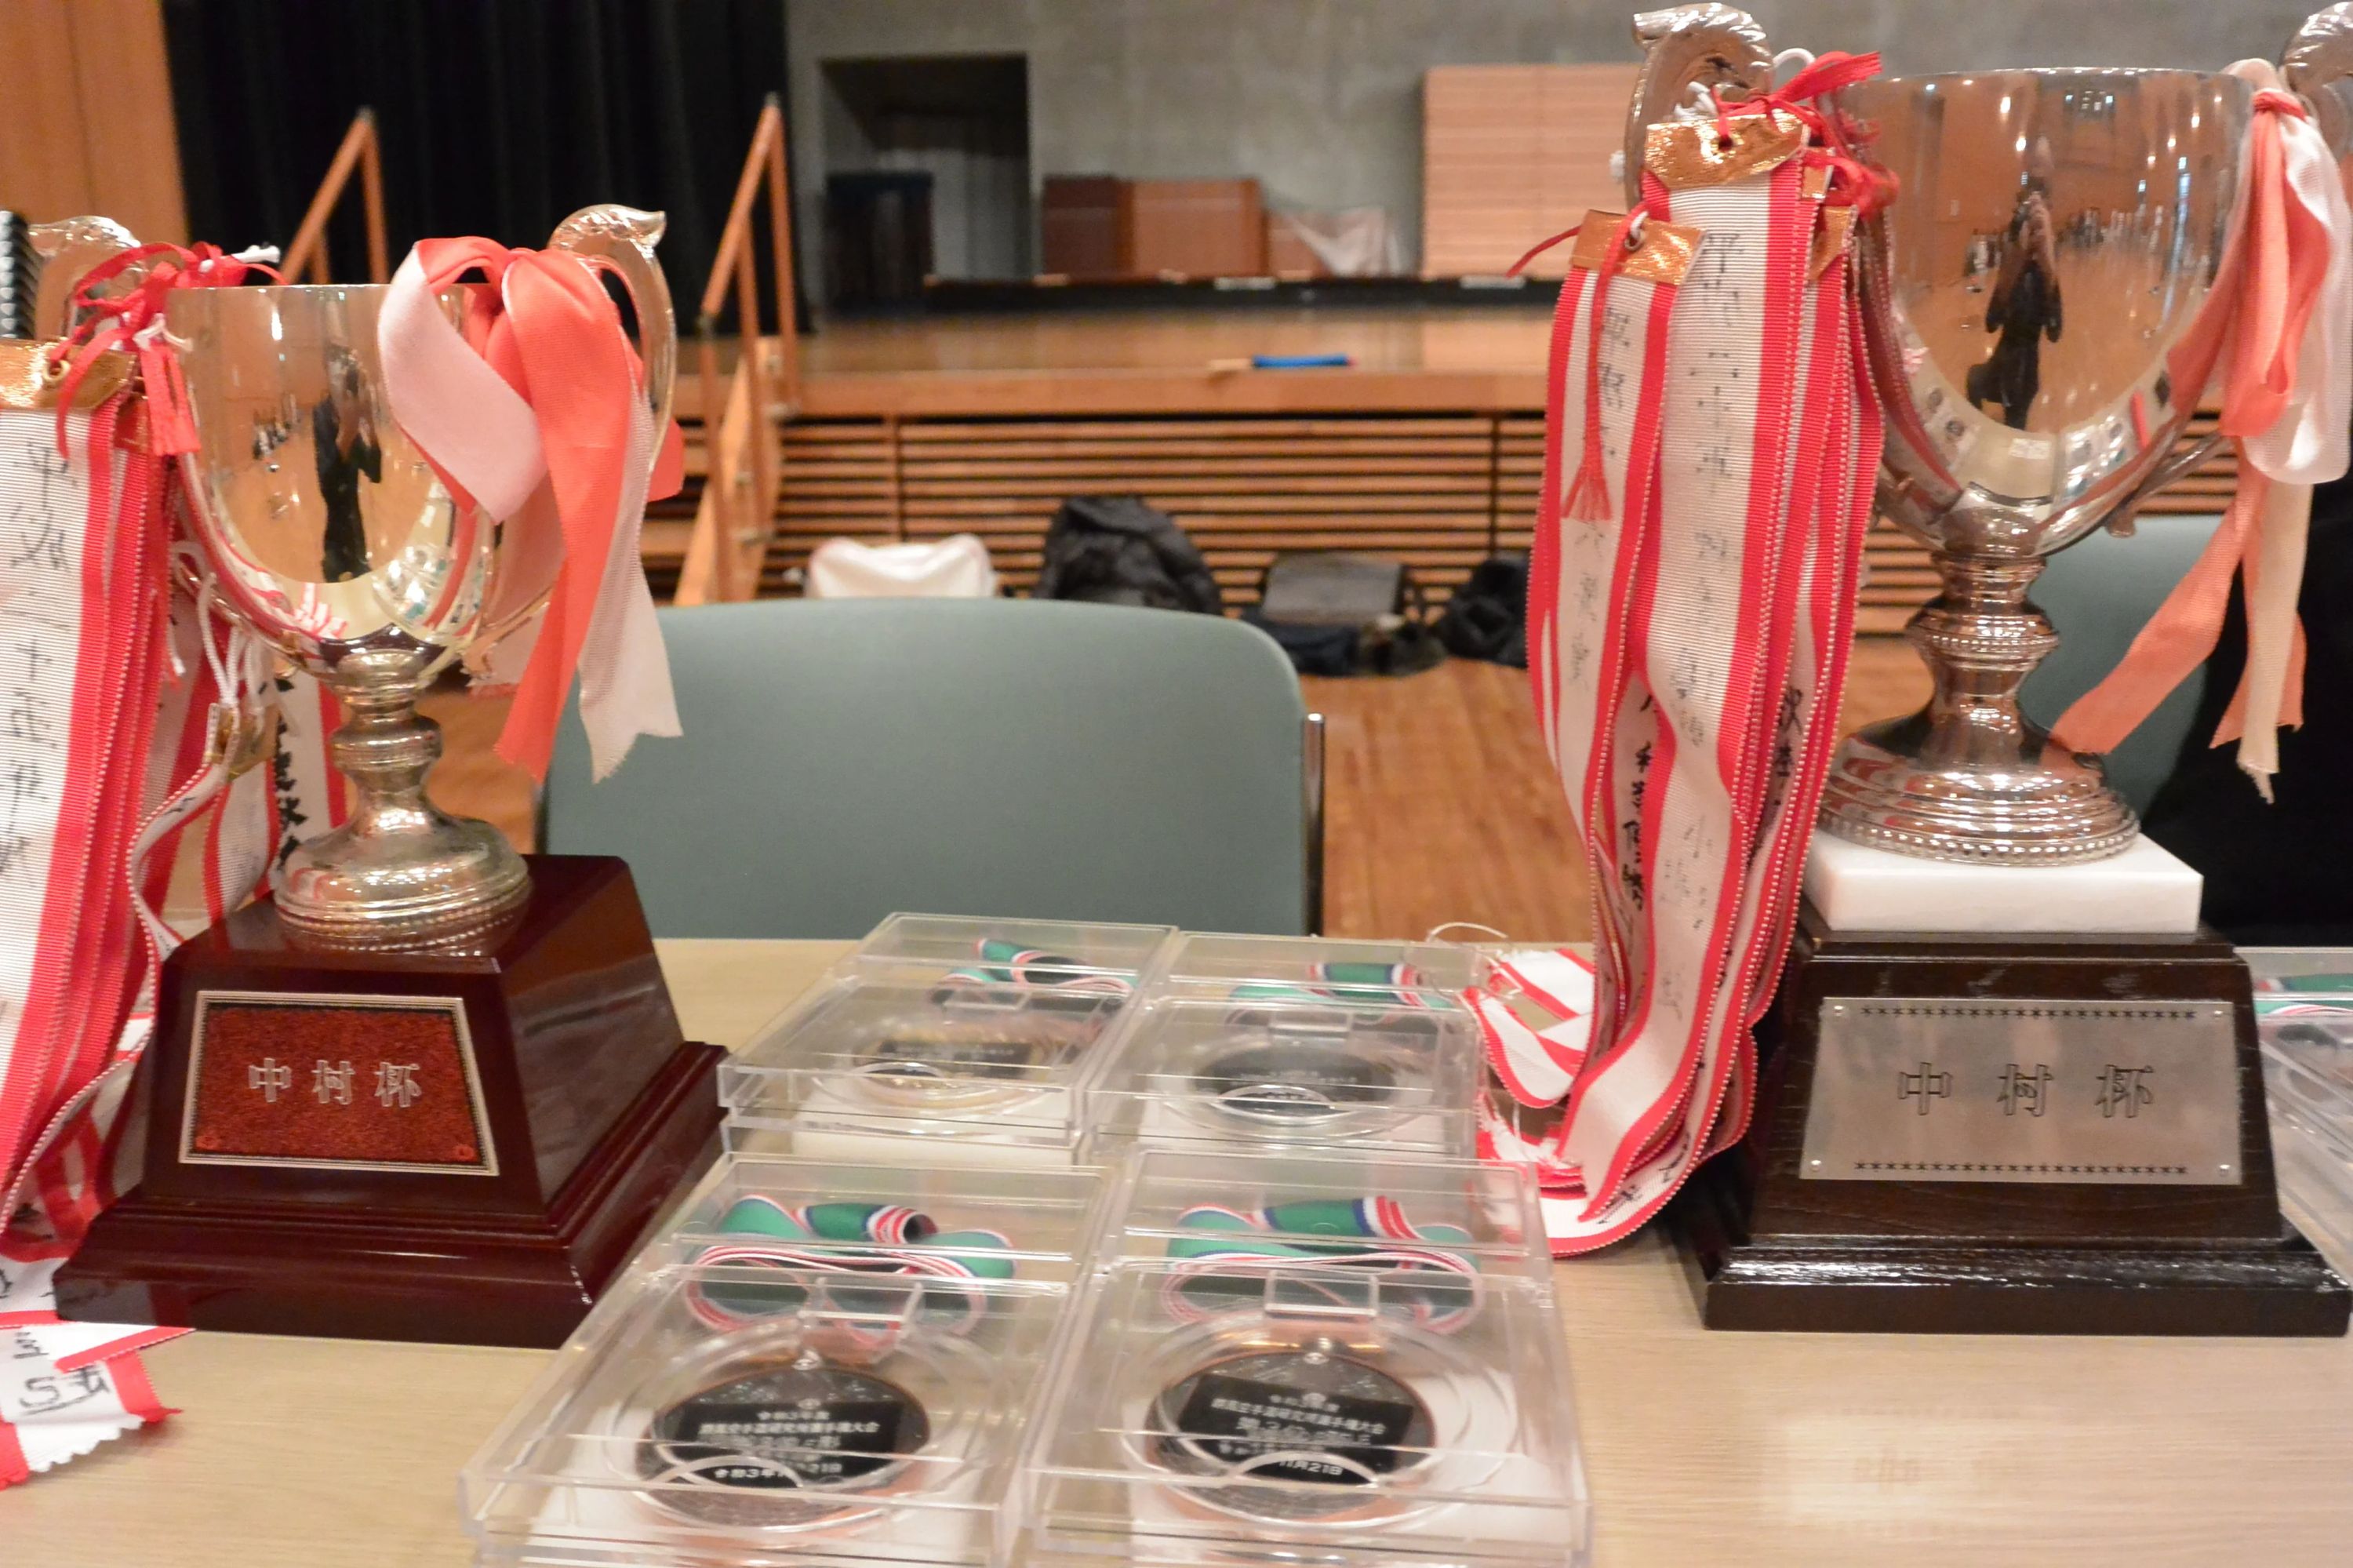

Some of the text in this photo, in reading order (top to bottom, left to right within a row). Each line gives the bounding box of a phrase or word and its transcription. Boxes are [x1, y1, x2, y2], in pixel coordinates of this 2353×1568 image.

[249, 1057, 422, 1108] 中村杯
[1897, 1061, 2155, 1119] 中村杯
